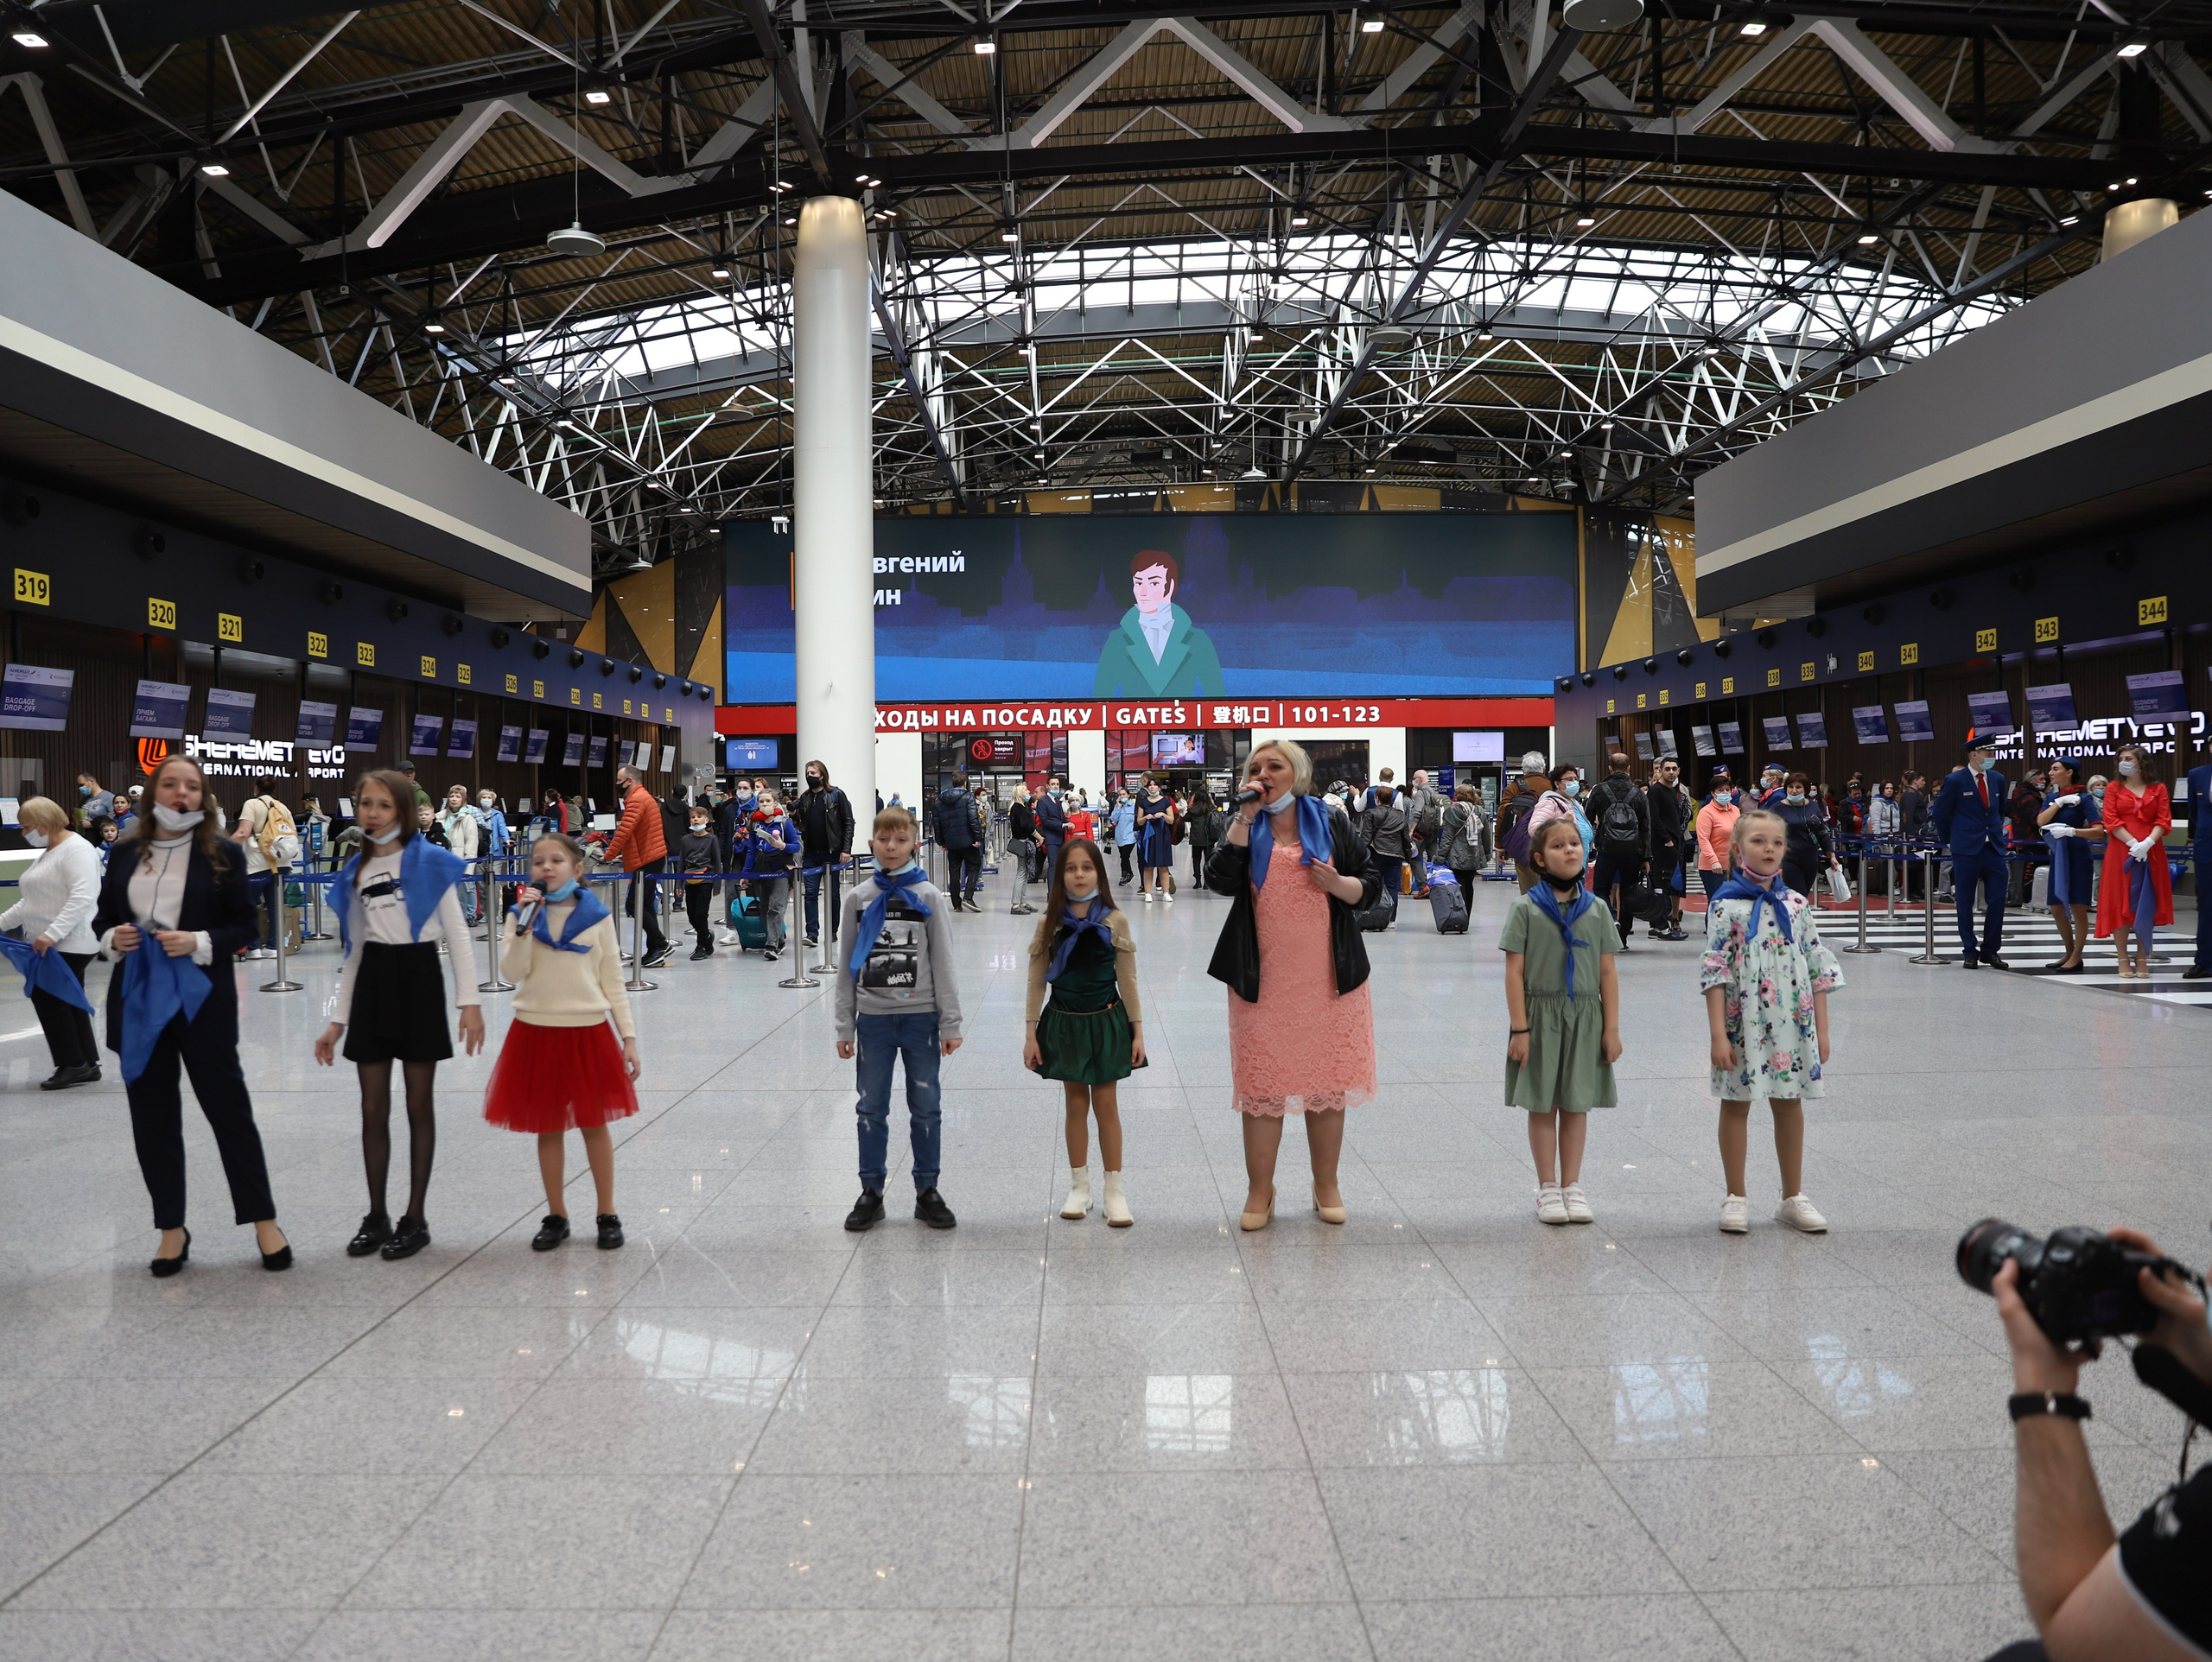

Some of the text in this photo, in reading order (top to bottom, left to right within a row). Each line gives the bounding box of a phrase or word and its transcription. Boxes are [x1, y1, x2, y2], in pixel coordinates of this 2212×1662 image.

[873, 550, 965, 574] вгений
[17, 574, 48, 599] 319
[874, 589, 901, 606] ин
[150, 603, 174, 625] 320
[2140, 601, 2165, 621] 344
[221, 618, 240, 638] 321
[2037, 621, 2056, 639] 343
[309, 637, 326, 654] 322
[1977, 633, 1995, 649] 342
[359, 646, 373, 663] 323
[1859, 655, 1873, 669] 340
[1902, 647, 1916, 662] 341
[423, 660, 435, 674] 324
[459, 668, 470, 681] 325
[1802, 666, 1814, 678] 339
[507, 677, 517, 690] 326
[1724, 680, 1733, 692] 337
[1768, 672, 1779, 684] 338
[535, 683, 543, 695] 327
[1696, 686, 1705, 696] 336
[3, 704, 37, 713] DROP-OFF
[5, 696, 36, 706] BAGGAGE
[874, 707, 1092, 730] ХОДЫ НА ПОСАДКУ
[1116, 707, 1186, 724] GATES
[1212, 705, 1270, 724] 登机口
[1292, 706, 1381, 722] 101-123
[1995, 744, 2117, 761] INTENATIONAL
[197, 763, 291, 778] ERNATIONAL
